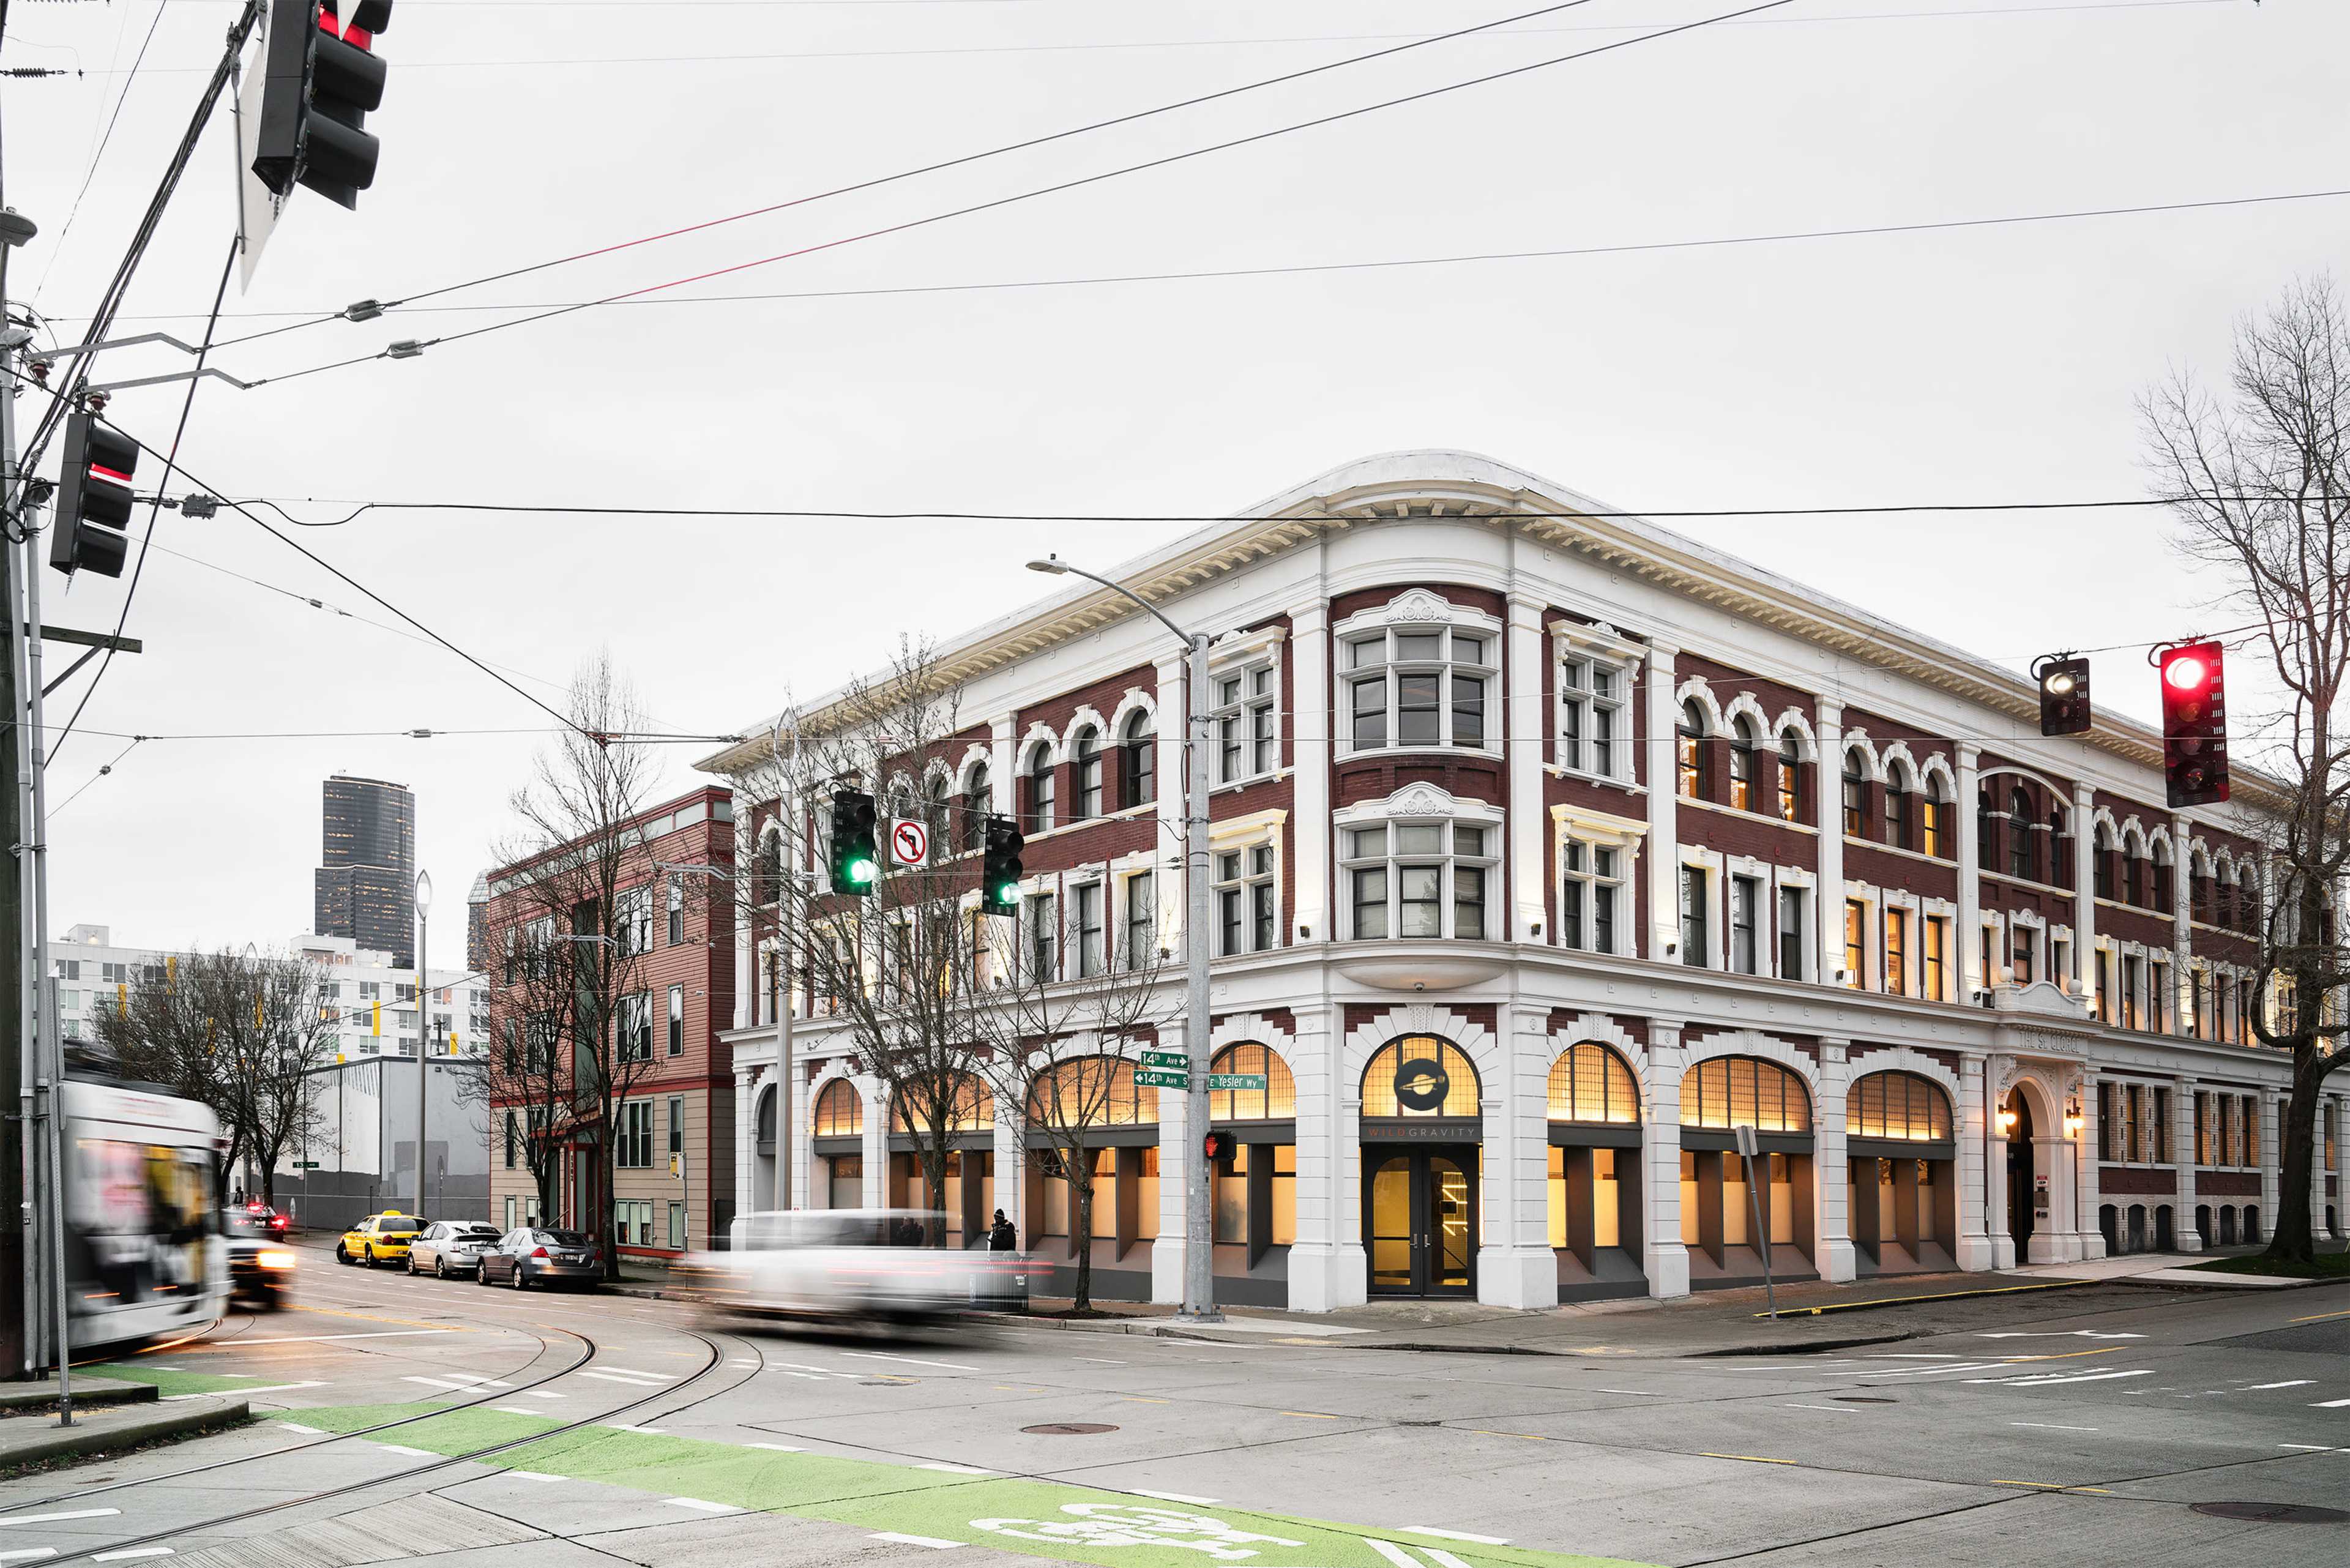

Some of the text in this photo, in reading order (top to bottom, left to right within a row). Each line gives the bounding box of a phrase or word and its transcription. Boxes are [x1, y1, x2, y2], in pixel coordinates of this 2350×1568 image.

[2019, 1031, 2035, 1048] THE
[2051, 1034, 2081, 1053] GEORGE
[1143, 1052, 1178, 1065] 14th Ave
[1144, 1073, 1163, 1085] 14th
[1165, 1076, 1177, 1085] Ave
[1218, 1075, 1244, 1087] Yesler
[1246, 1079, 1257, 1089] Wy
